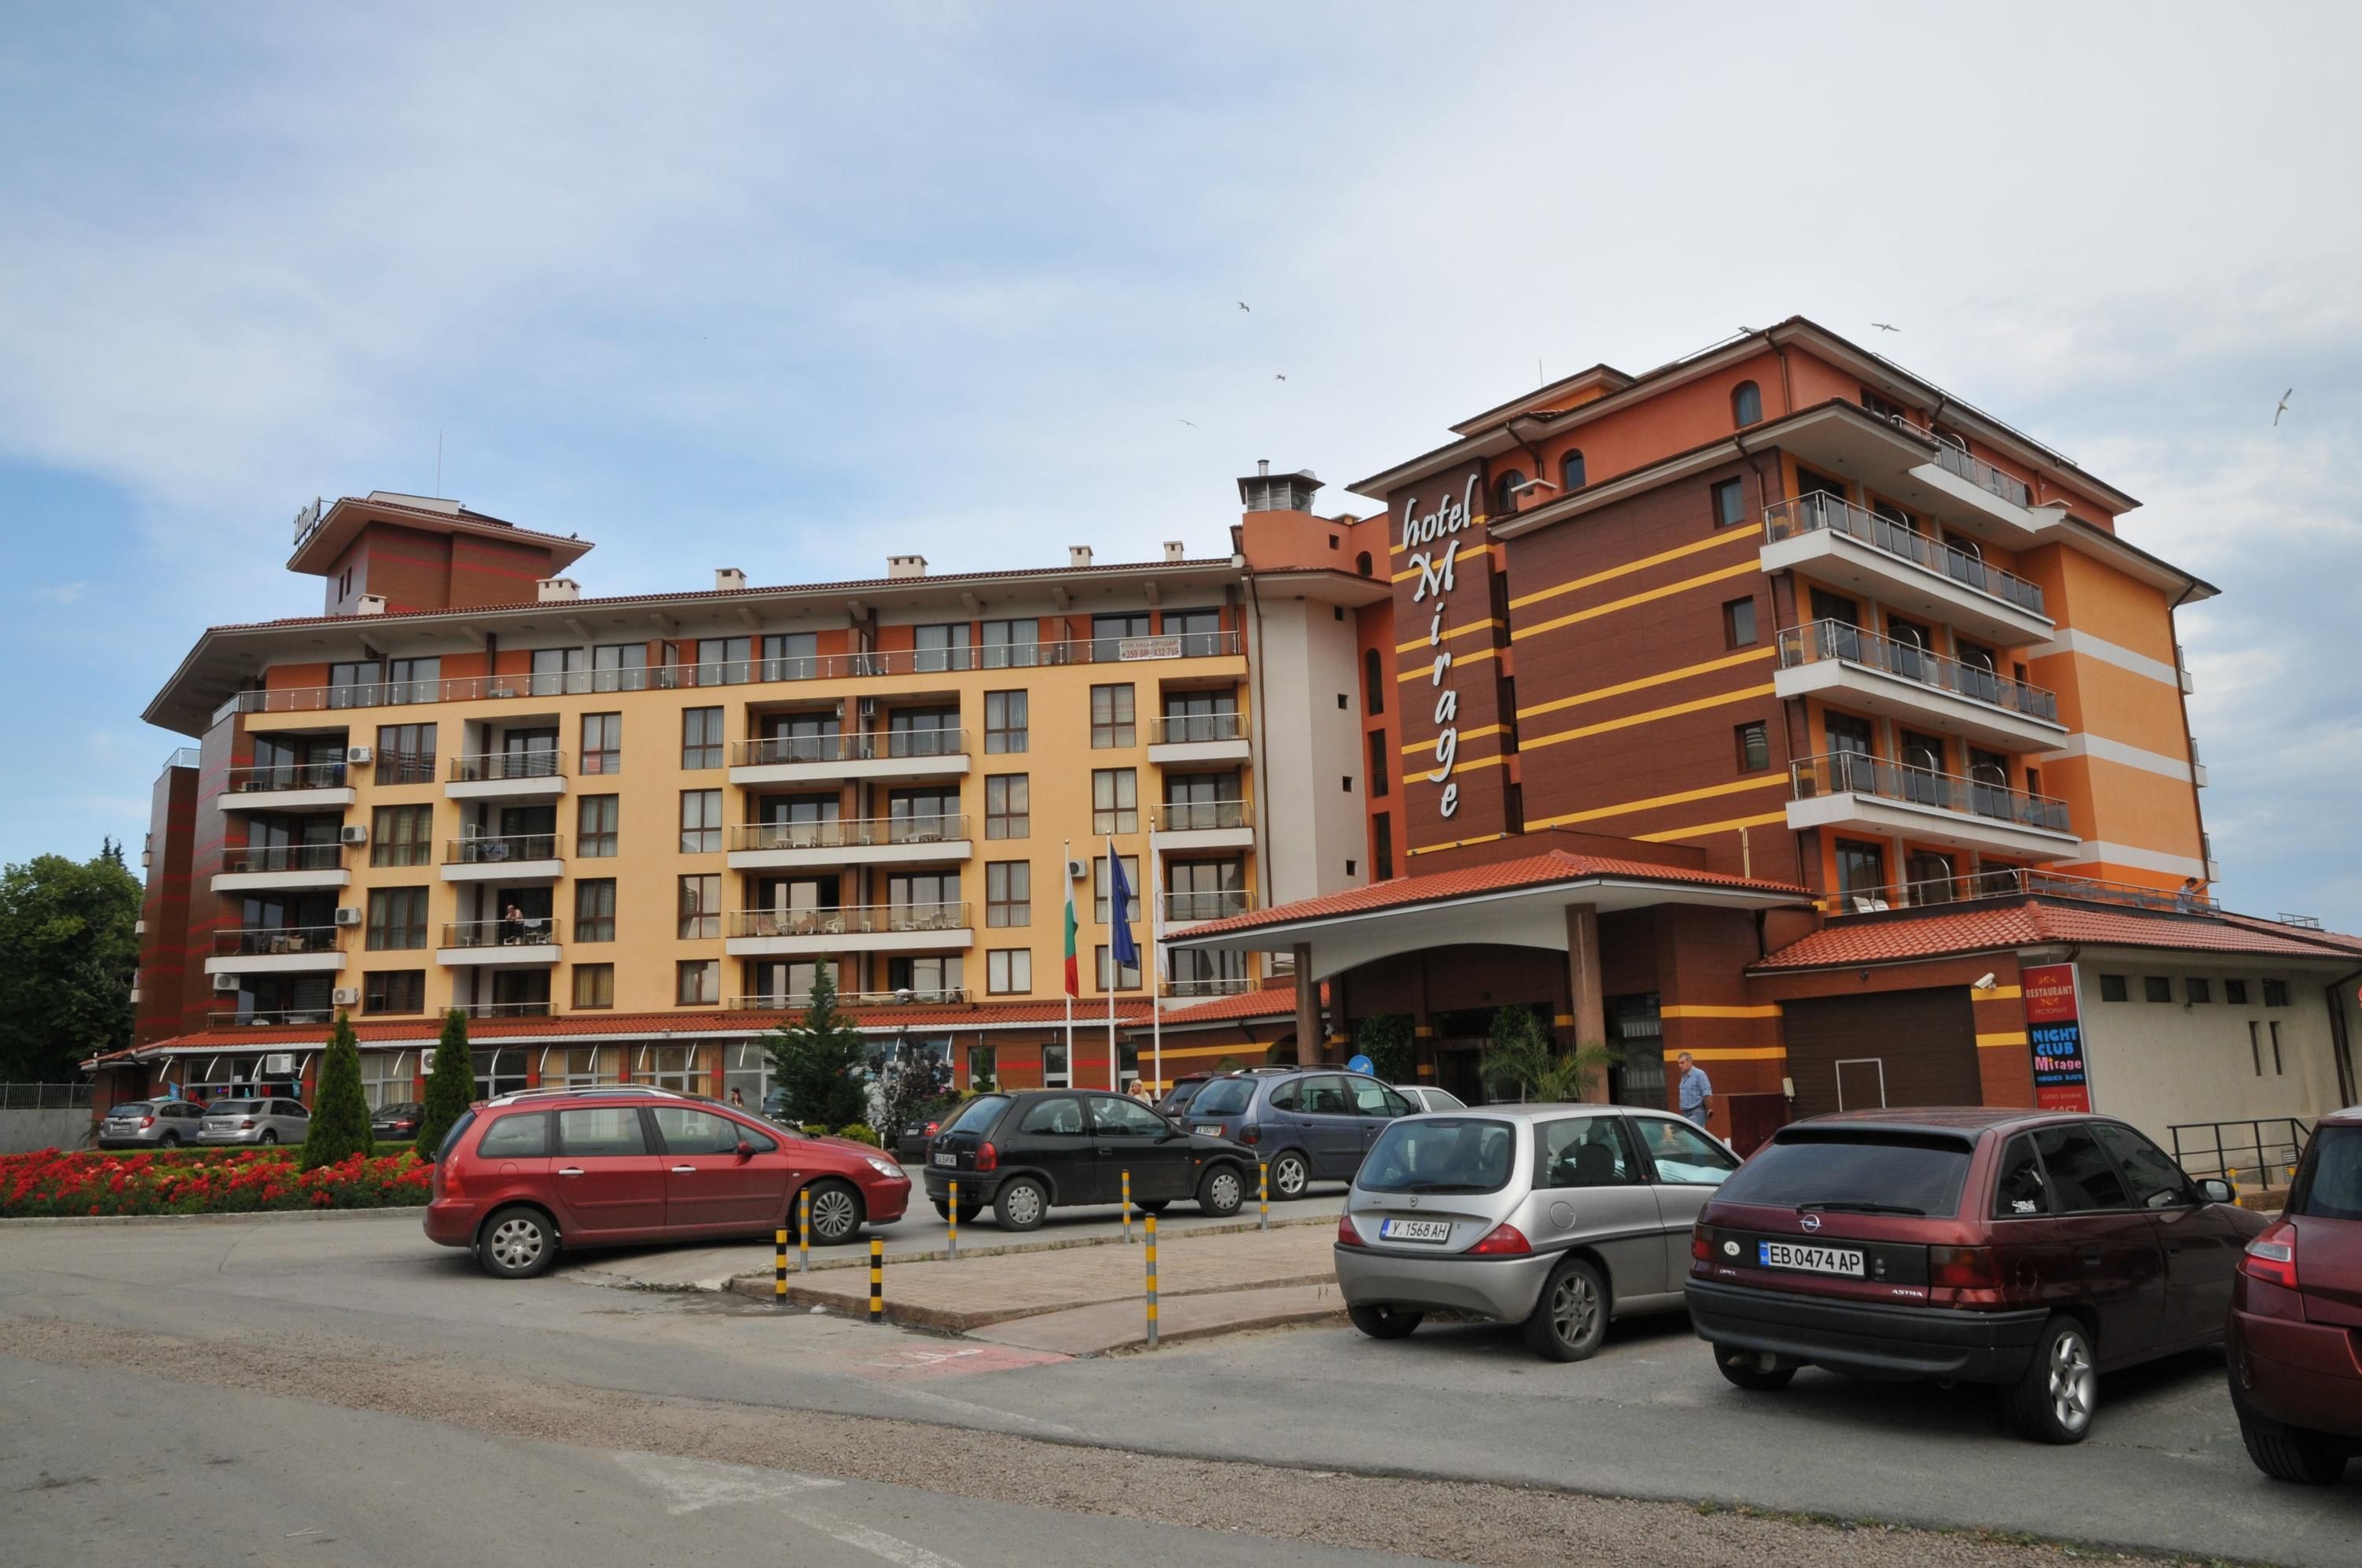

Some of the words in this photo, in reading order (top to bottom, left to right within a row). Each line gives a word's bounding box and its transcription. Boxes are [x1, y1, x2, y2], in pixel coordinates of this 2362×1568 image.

[1403, 473, 1479, 549] hotel
[1409, 540, 1460, 818] Mirage
[2025, 986, 2073, 998] RESTAURANT
[2033, 1027, 2077, 1043] NIGHT
[2037, 1042, 2074, 1056] CLUB
[2035, 1056, 2082, 1071] Mirage
[1393, 1222, 1401, 1235] Y
[1405, 1222, 1431, 1237] 1568
[1431, 1224, 1447, 1238] AH
[1770, 1245, 1791, 1264] EB
[1794, 1248, 1834, 1270] 0474
[1839, 1252, 1860, 1271] AP
[1891, 1289, 1923, 1297] ASTRA
